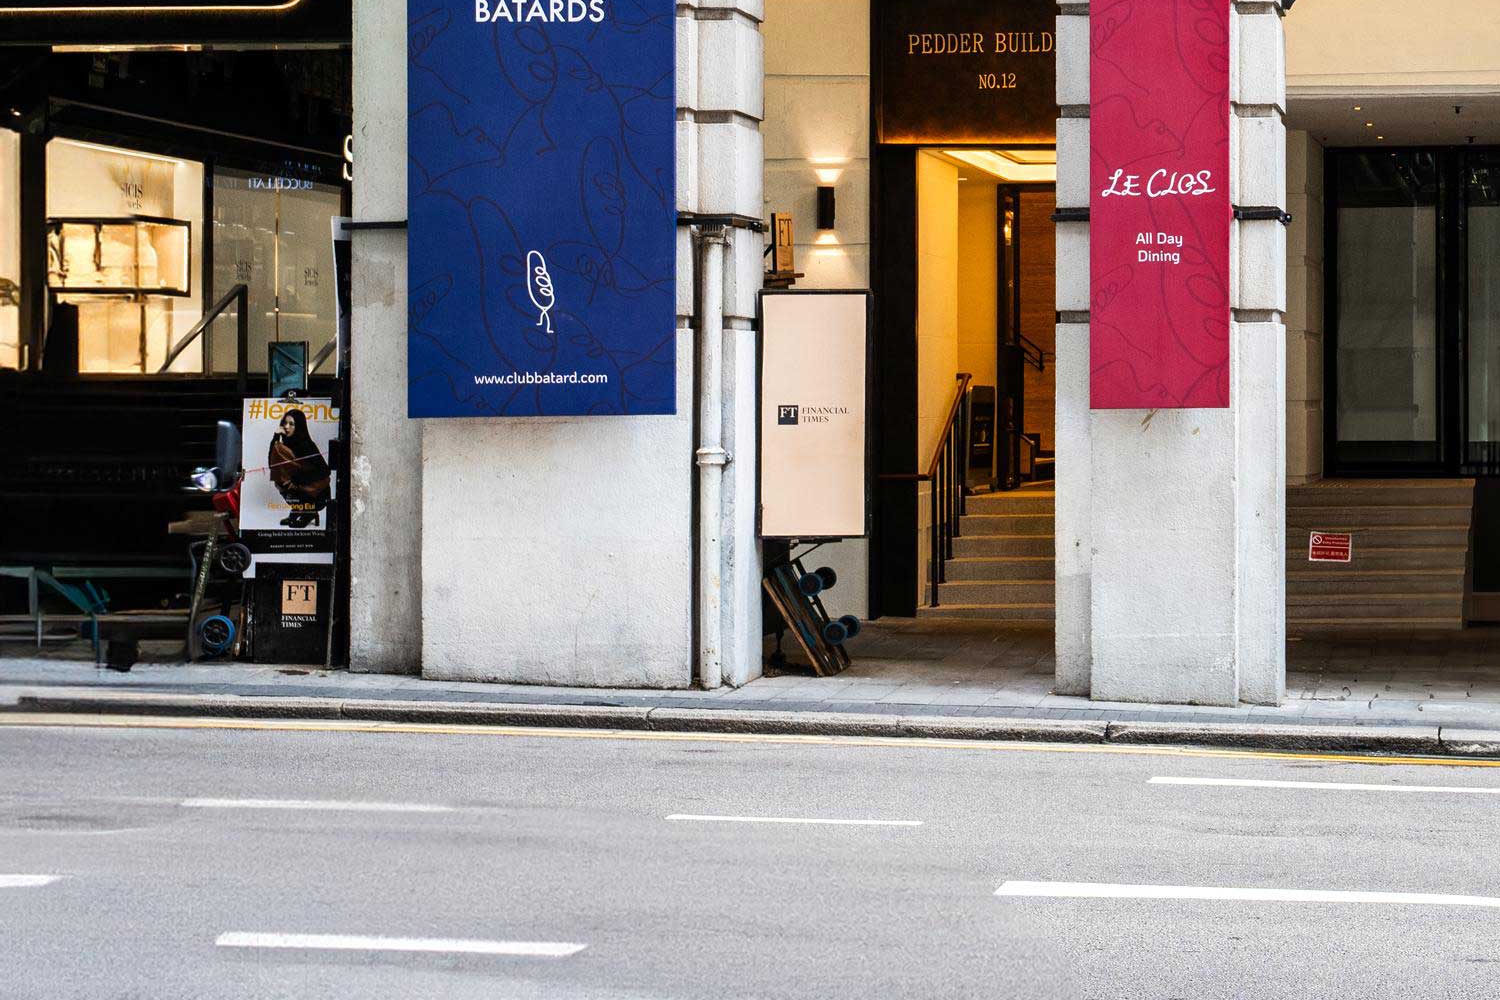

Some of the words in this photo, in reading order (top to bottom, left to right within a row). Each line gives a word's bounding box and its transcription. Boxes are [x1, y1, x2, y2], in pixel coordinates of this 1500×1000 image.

[908, 32, 984, 55] PEDDER
[995, 31, 1056, 53] BUILD
[979, 73, 1016, 89] NO.12
[1101, 168, 1141, 197] LE
[1146, 168, 1216, 197] CLOS
[778, 218, 792, 246] FT
[1135, 232, 1153, 245] All
[1157, 232, 1183, 248] Day
[1138, 249, 1180, 265] Dining
[474, 370, 608, 386] www.clubbatard.com
[779, 406, 798, 418] FT
[801, 406, 850, 415] FINANCIAL
[801, 415, 829, 424] TIMES
[286, 584, 315, 601] FT
[281, 614, 318, 622] FINANCIAL
